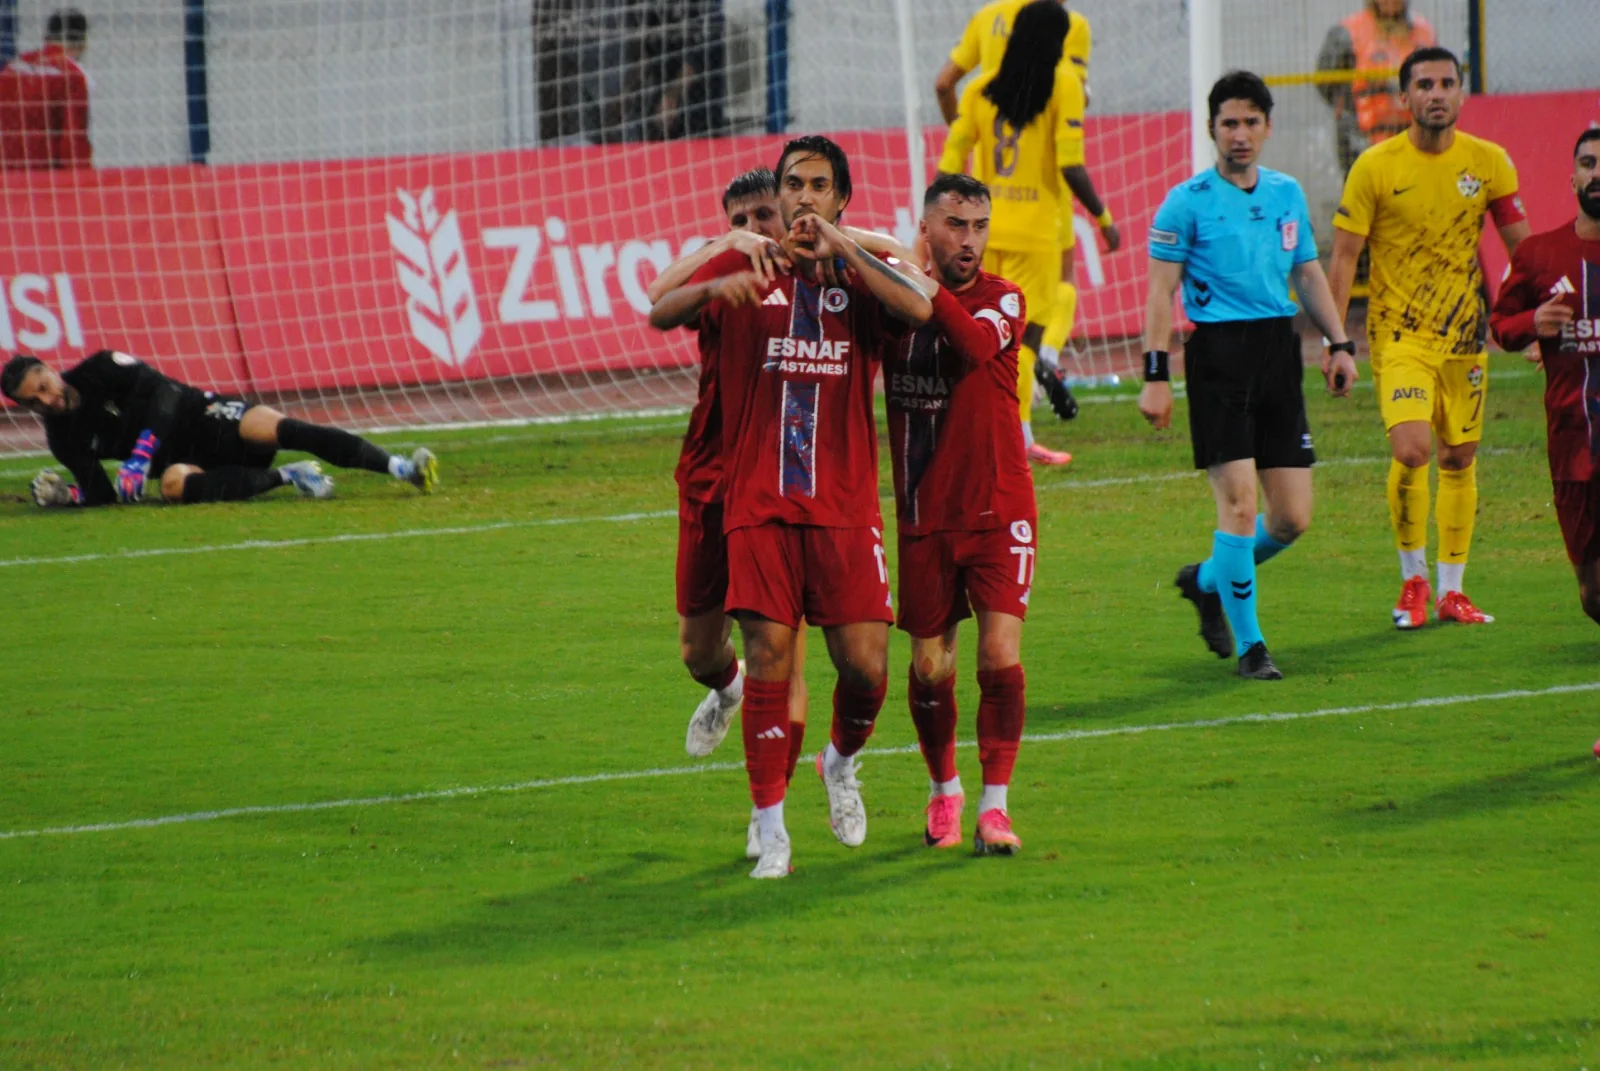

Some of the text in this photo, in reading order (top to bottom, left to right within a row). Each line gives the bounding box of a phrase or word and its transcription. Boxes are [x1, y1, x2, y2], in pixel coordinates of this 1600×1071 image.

[482, 216, 713, 323] Zira
[0, 272, 84, 351] SI
[767, 337, 850, 360] ESNAF
[1470, 389, 1483, 422] 7
